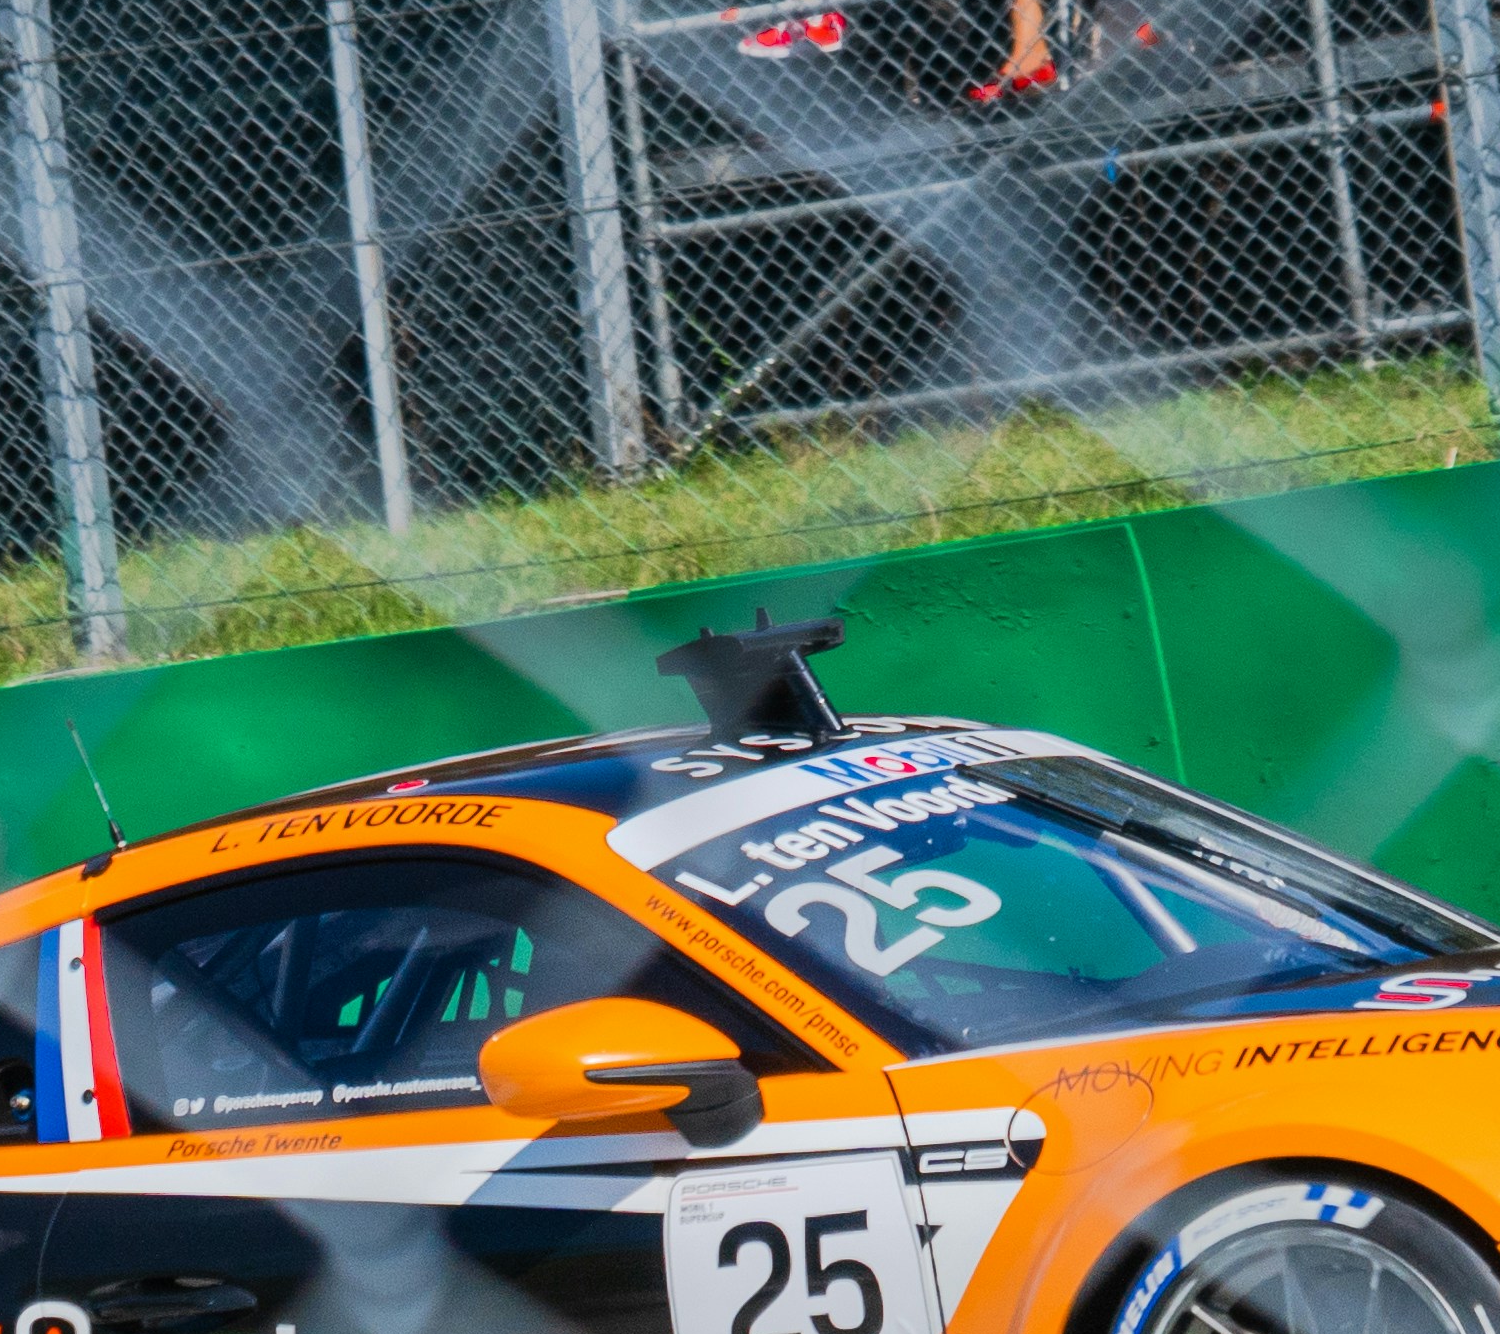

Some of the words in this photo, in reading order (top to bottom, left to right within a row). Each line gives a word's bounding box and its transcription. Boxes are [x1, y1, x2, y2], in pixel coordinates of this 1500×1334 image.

[799, 740, 981, 788] Mobil
[209, 830, 240, 855] L.
[257, 810, 339, 844] TEN
[342, 802, 513, 829] VOORDE
[674, 870, 774, 907] L.
[740, 819, 865, 870] ten
[764, 844, 1003, 978] 25
[645, 894, 860, 1058] www.porsche.com/pmsc
[1051, 1049, 1224, 1100] MOVING
[165, 1137, 255, 1159] Porsche
[262, 1131, 343, 1153] Twente
[681, 1176, 788, 1195] PORSCHE
